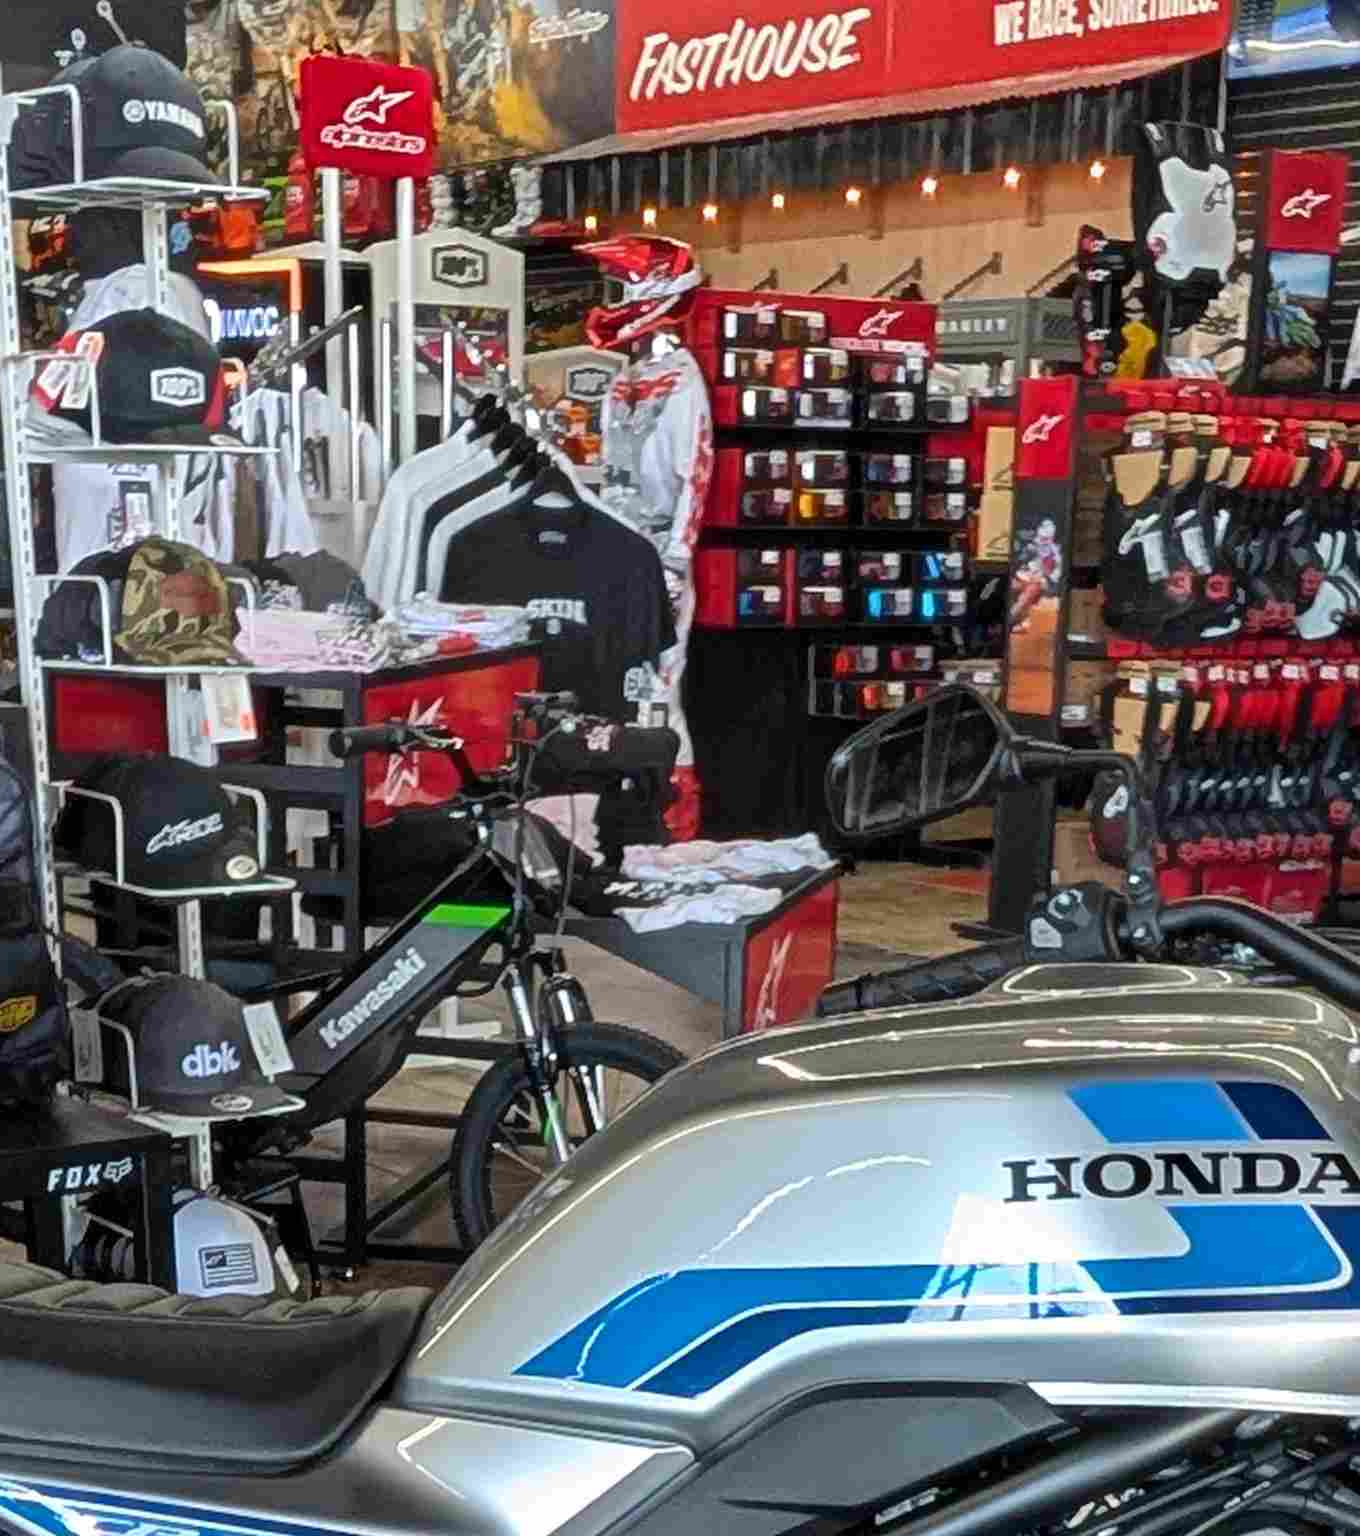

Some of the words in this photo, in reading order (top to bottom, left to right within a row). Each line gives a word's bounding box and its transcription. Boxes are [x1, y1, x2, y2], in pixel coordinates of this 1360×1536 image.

[993, 1, 1027, 46] WE
[1028, 0, 1084, 38] RACE,
[630, 8, 872, 101] FASTHOUSE
[320, 947, 427, 1049] Kawasaki
[181, 1041, 241, 1077] dbk
[47, 1163, 102, 1192] FOX
